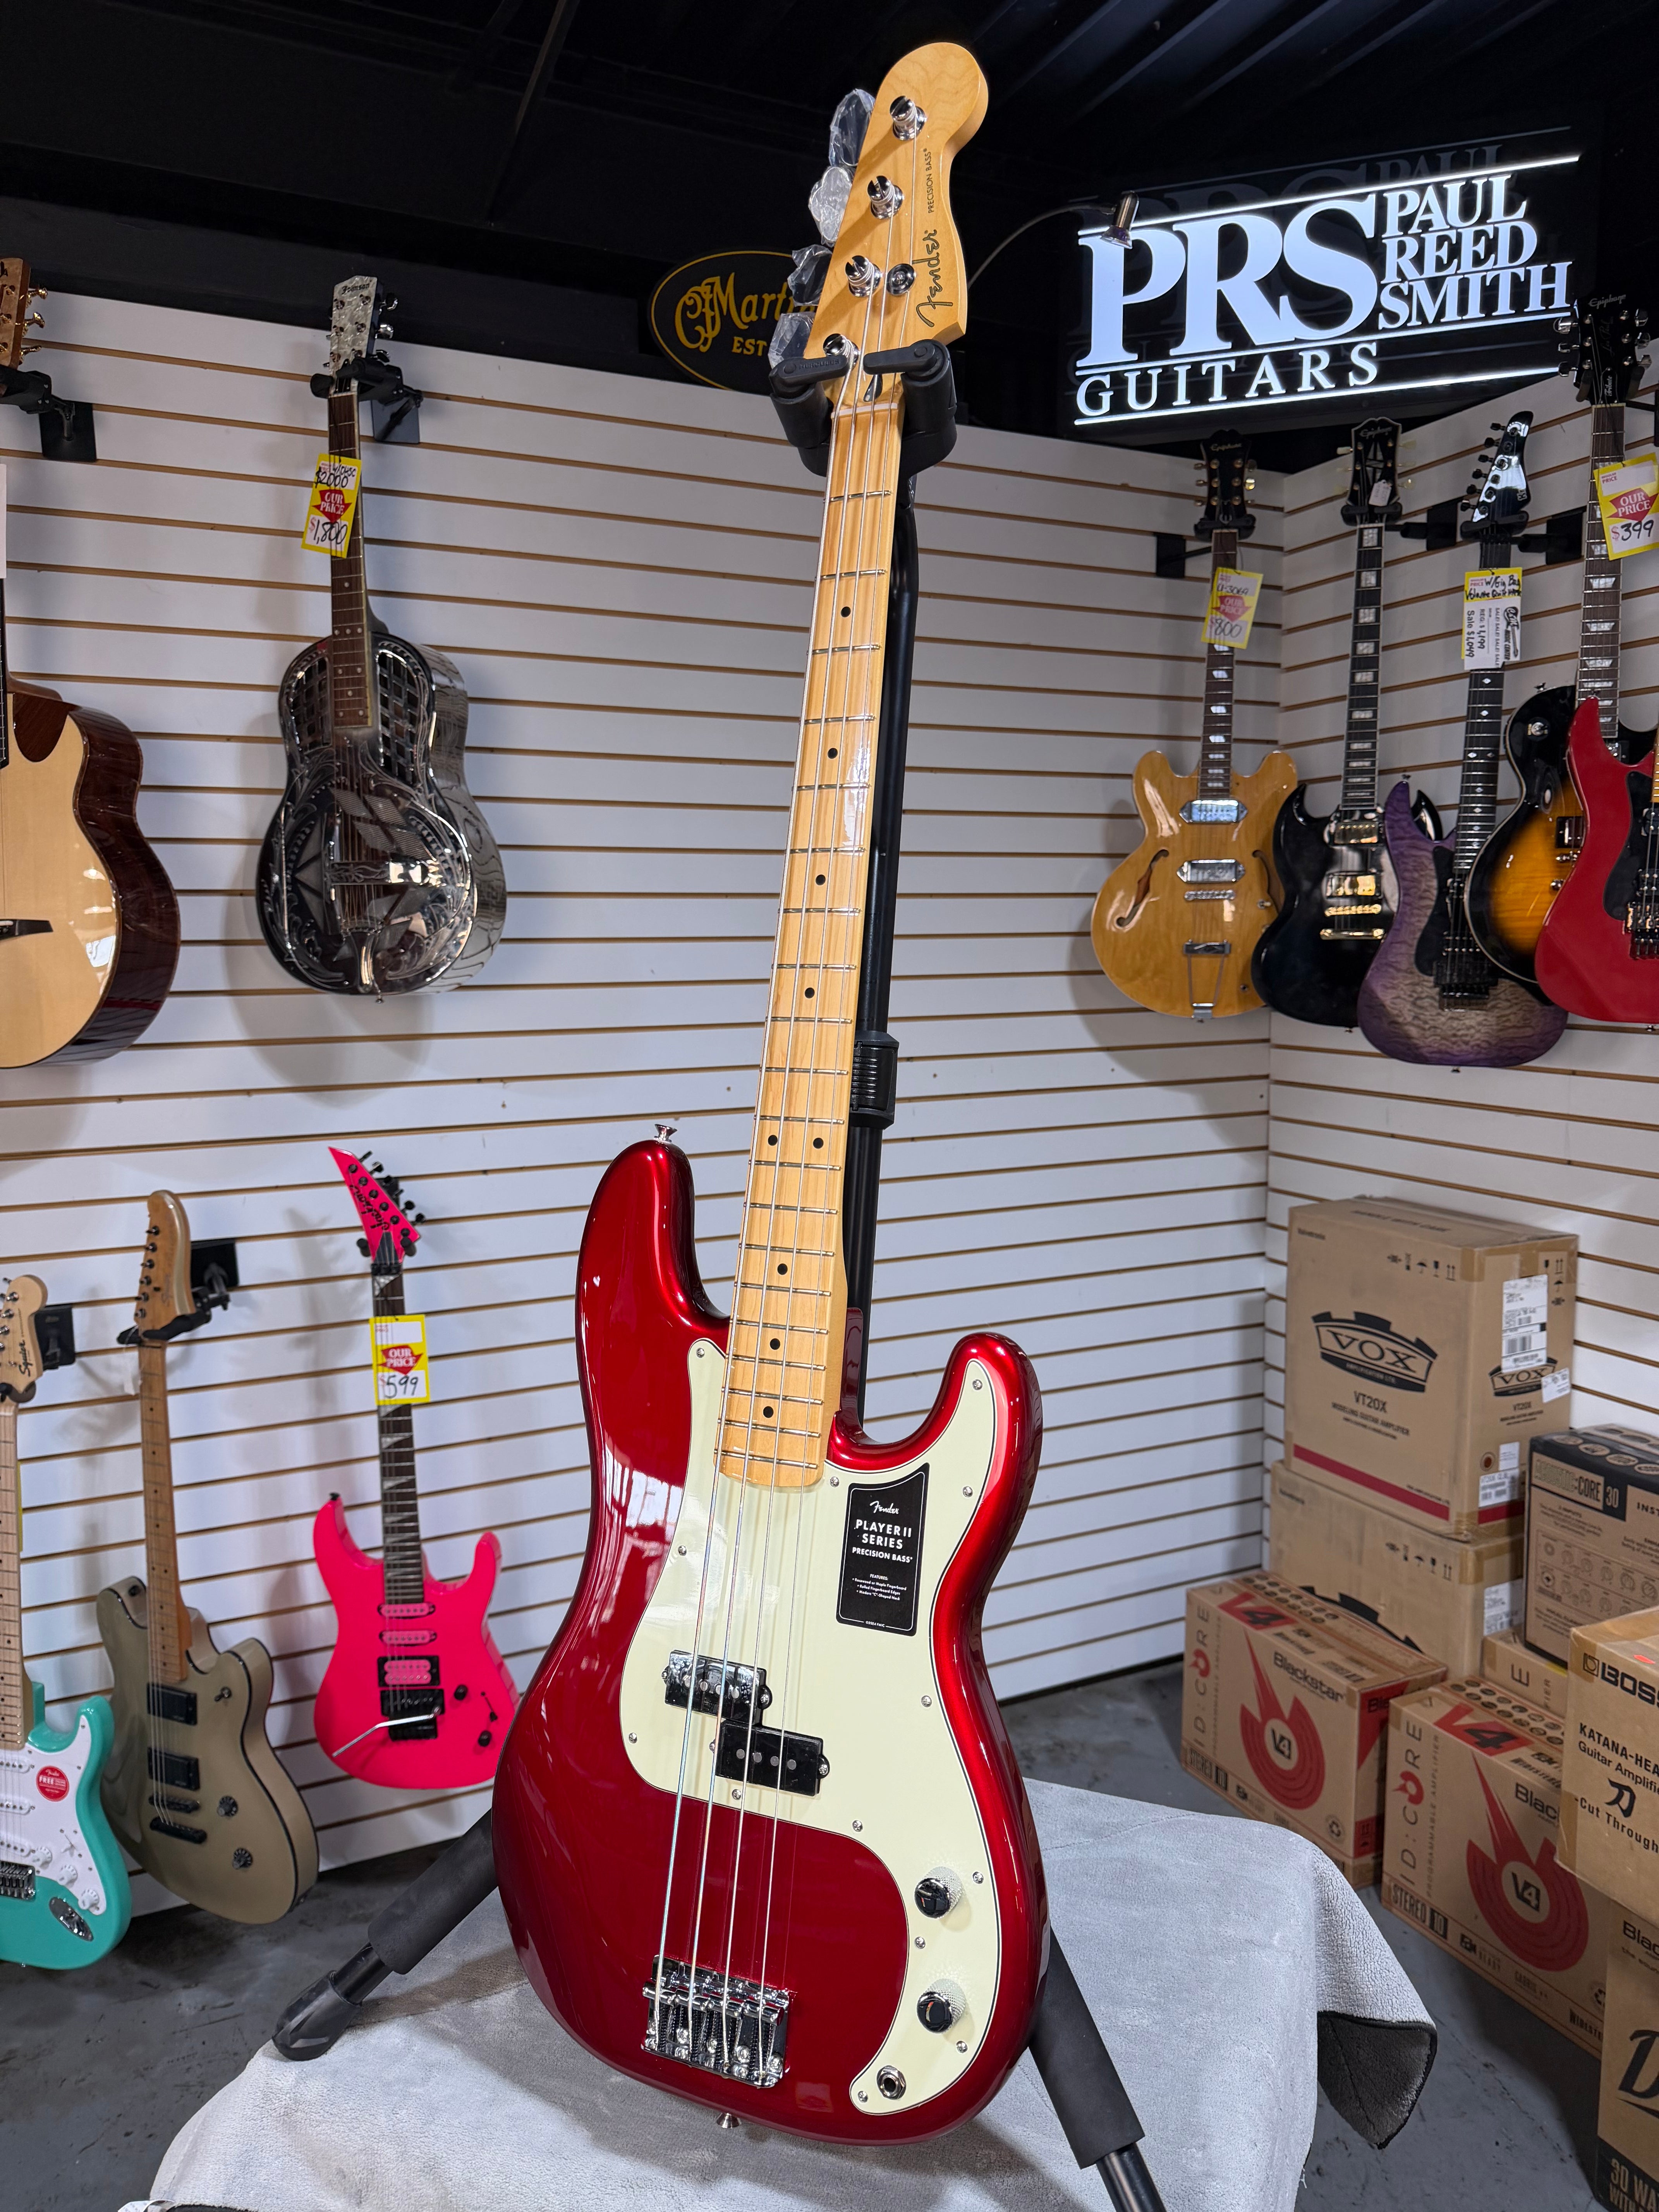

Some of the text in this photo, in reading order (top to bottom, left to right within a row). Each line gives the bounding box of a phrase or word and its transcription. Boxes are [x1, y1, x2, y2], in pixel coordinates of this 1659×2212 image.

[926, 173, 934, 213] PRECISION
[1381, 174, 1527, 237] PAUL
[1381, 221, 1538, 283] REED
[916, 228, 953, 327] Fender
[1077, 194, 1377, 367] PRS
[1378, 262, 1573, 330] SMITH
[1588, 294, 1626, 309] Epiphone
[732, 337, 767, 357] EST
[1076, 343, 1378, 417] GUITARS
[320, 502, 345, 515] PRICE
[325, 492, 343, 503] OUR
[1618, 500, 1651, 517] PRICE
[1620, 491, 1645, 507] OUR
[1611, 520, 1654, 541] $399
[387, 1357, 416, 1367] PRICE
[388, 1348, 411, 1358] OUR
[1326, 1329, 1417, 1373] VOX
[380, 1375, 418, 1399] $599
[1499, 1368, 1548, 1384] VOX
[1354, 1390, 1388, 1413] VT20X
[870, 1501, 899, 1515] Fender
[1606, 1486, 1619, 1508] 30
[855, 1519, 912, 1538] PLAYER II
[862, 1533, 903, 1550] SERIES
[852, 1546, 890, 1560] PRECISION
[1274, 1650, 1344, 1702] Blackstar
[1601, 1661, 1659, 1709] BOS
[1579, 1741, 1612, 1767] Guitar
[39, 1775, 54, 1785] FREE
[1515, 1783, 1560, 1820] Blac
[1392, 1882, 1427, 1923] STEREO
[1611, 2158, 1659, 2212] 30 WA
